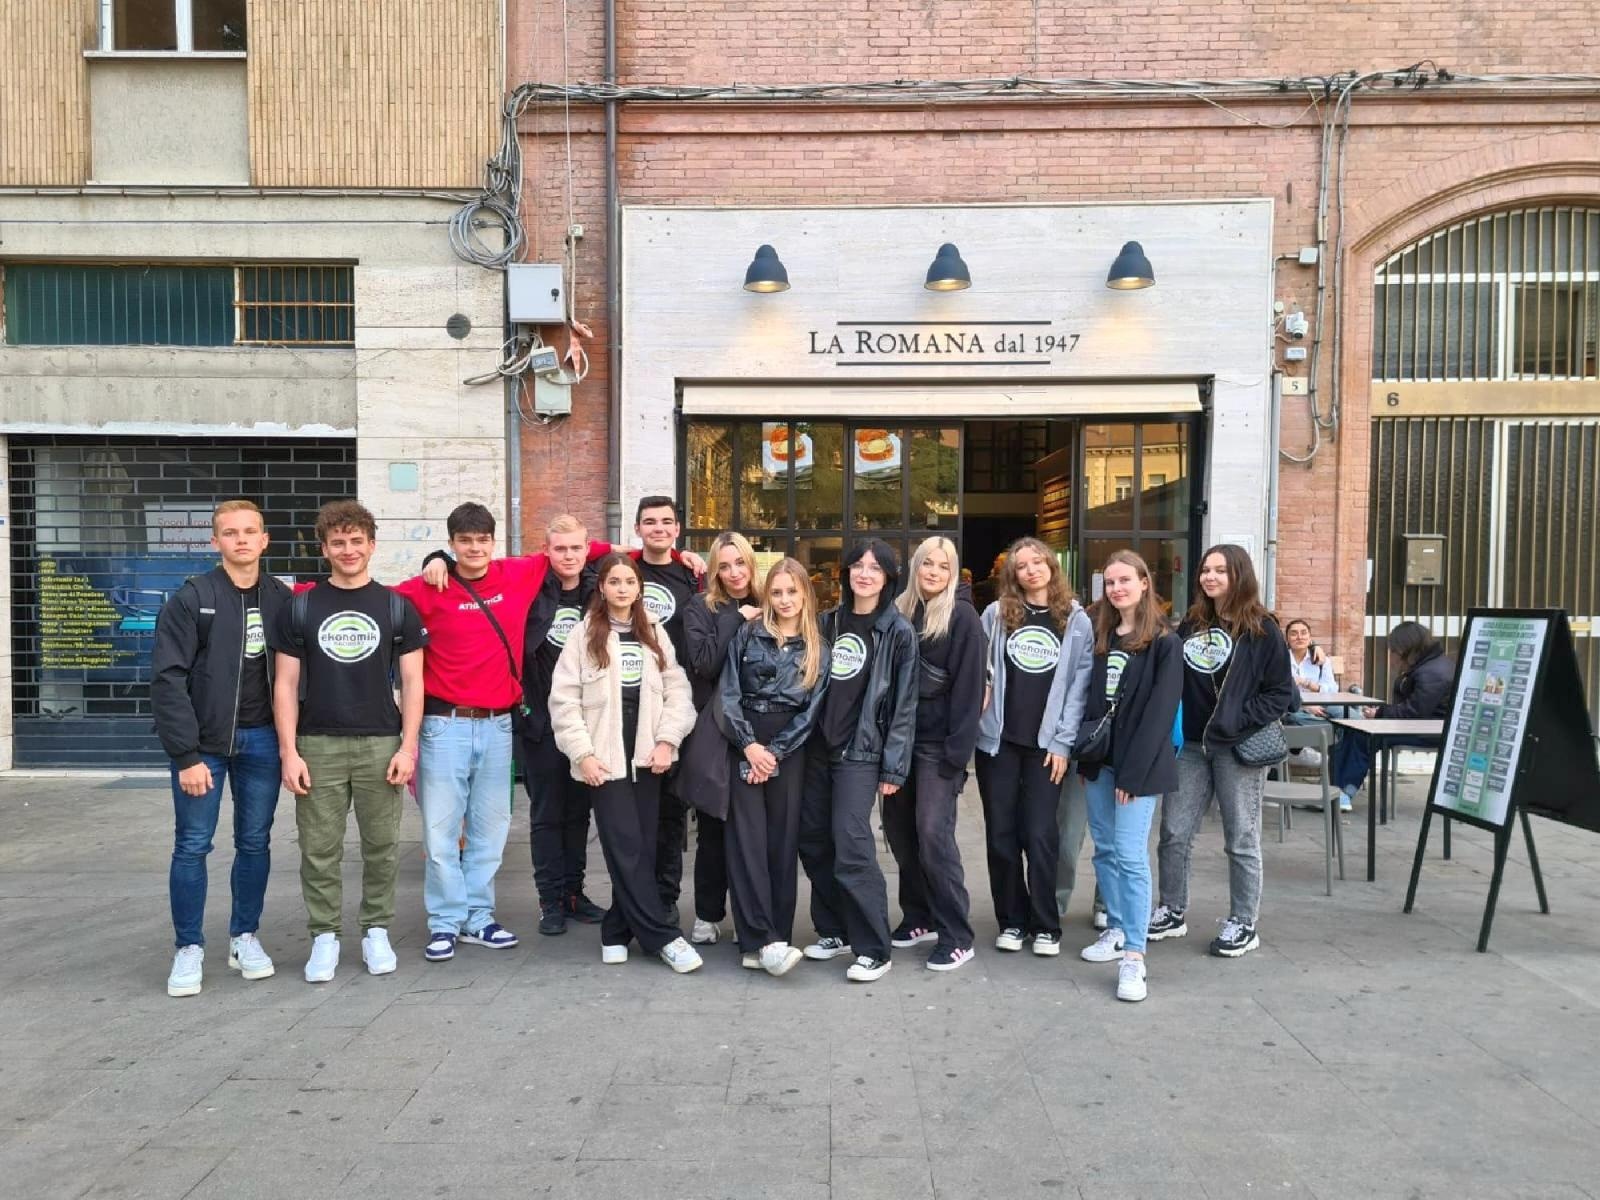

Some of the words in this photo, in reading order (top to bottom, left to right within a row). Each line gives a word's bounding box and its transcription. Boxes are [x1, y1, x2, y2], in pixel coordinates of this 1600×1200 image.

[808, 331, 844, 354] LA
[855, 330, 985, 354] ROMANA
[994, 333, 1025, 353] dal
[1034, 334, 1081, 353] 1947
[1291, 380, 1299, 391] 5
[1387, 391, 1399, 406] 6
[321, 632, 377, 641] ekonomik
[1009, 642, 1059, 658] ekonomik
